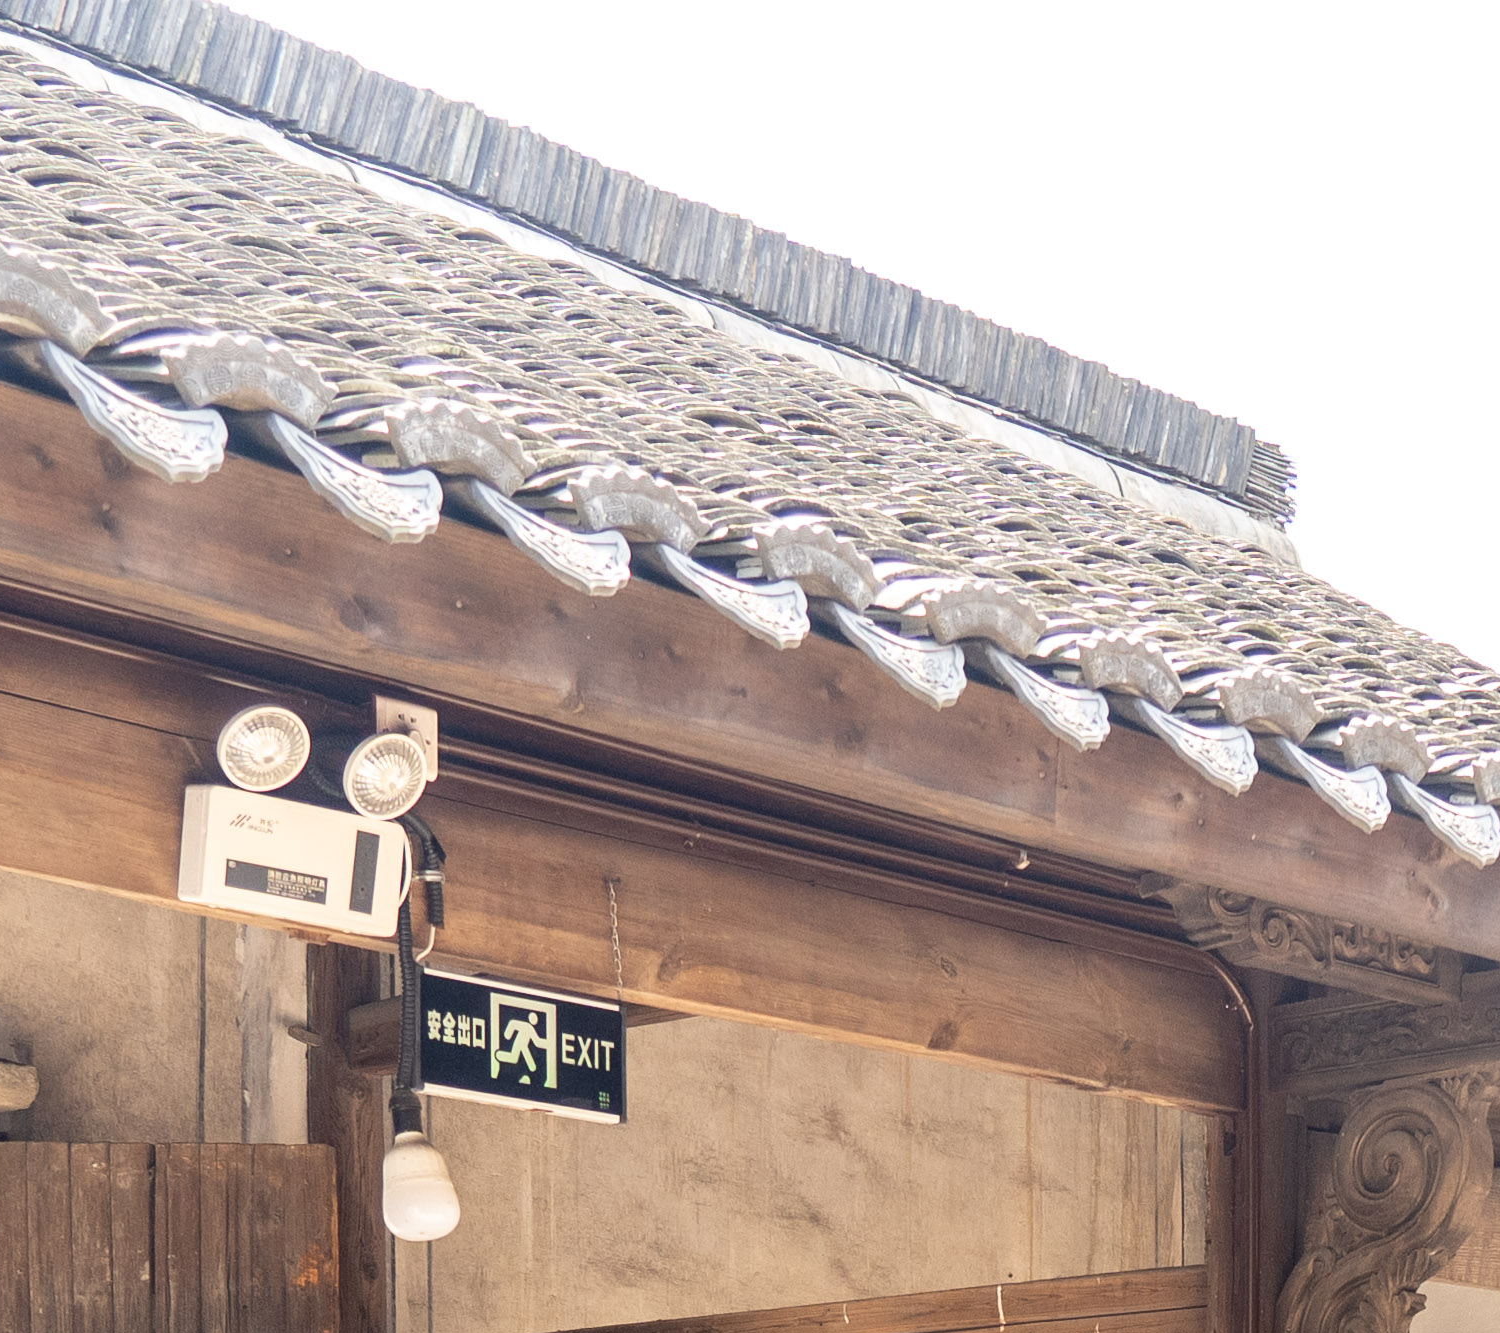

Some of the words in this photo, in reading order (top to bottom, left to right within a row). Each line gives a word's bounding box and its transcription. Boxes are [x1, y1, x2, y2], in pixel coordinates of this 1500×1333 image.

[427, 1009, 486, 1050] 安全出口
[561, 1032, 615, 1072] EXIT
